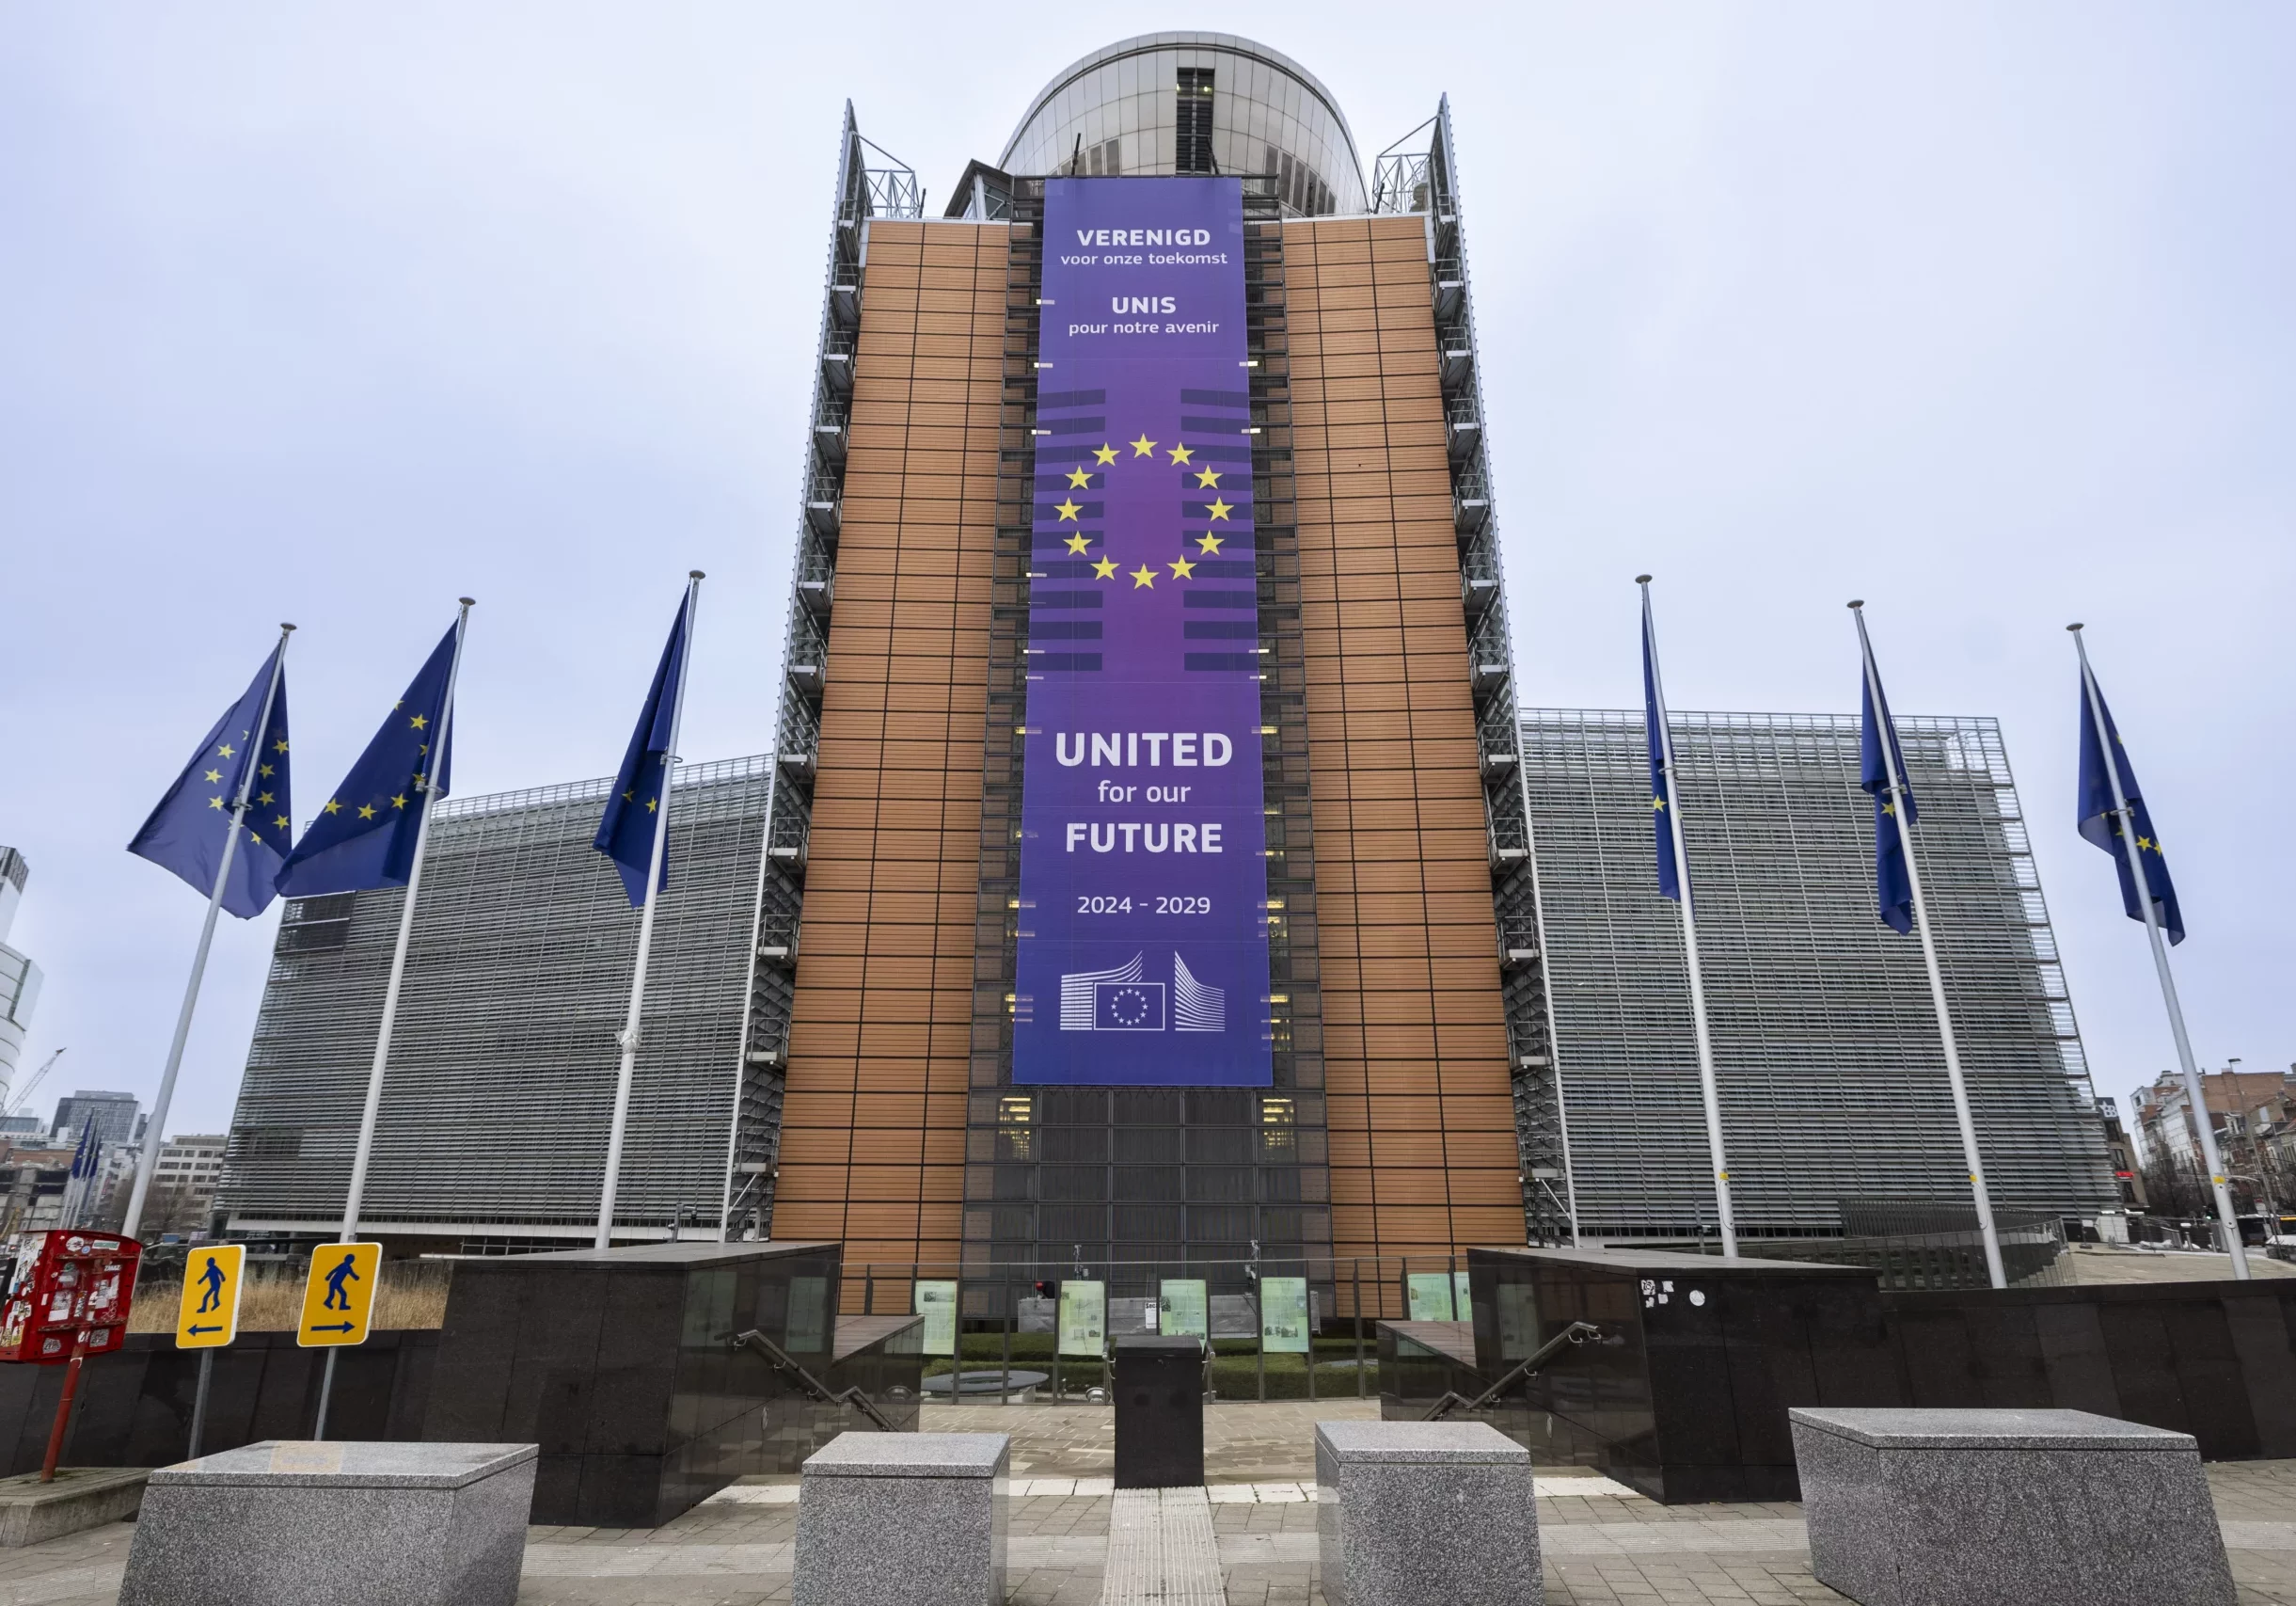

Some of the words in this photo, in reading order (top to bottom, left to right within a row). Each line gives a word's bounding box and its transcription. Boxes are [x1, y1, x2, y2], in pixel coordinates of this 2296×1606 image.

[1077, 230, 1211, 246] VERENIGD
[1060, 255, 1098, 264] voor
[1103, 255, 1142, 264] onze
[1148, 251, 1227, 264] toekomst
[1112, 296, 1177, 313] UNIS
[1069, 325, 1108, 337] pour
[1113, 321, 1159, 333] notre
[1164, 320, 1219, 333] avenir
[1056, 733, 1232, 766] UNITED
[1098, 780, 1136, 802] for
[1146, 787, 1191, 802] our
[1067, 823, 1222, 852] FUTURE
[1077, 897, 1132, 914] 2024
[1155, 897, 1211, 914] 2029
